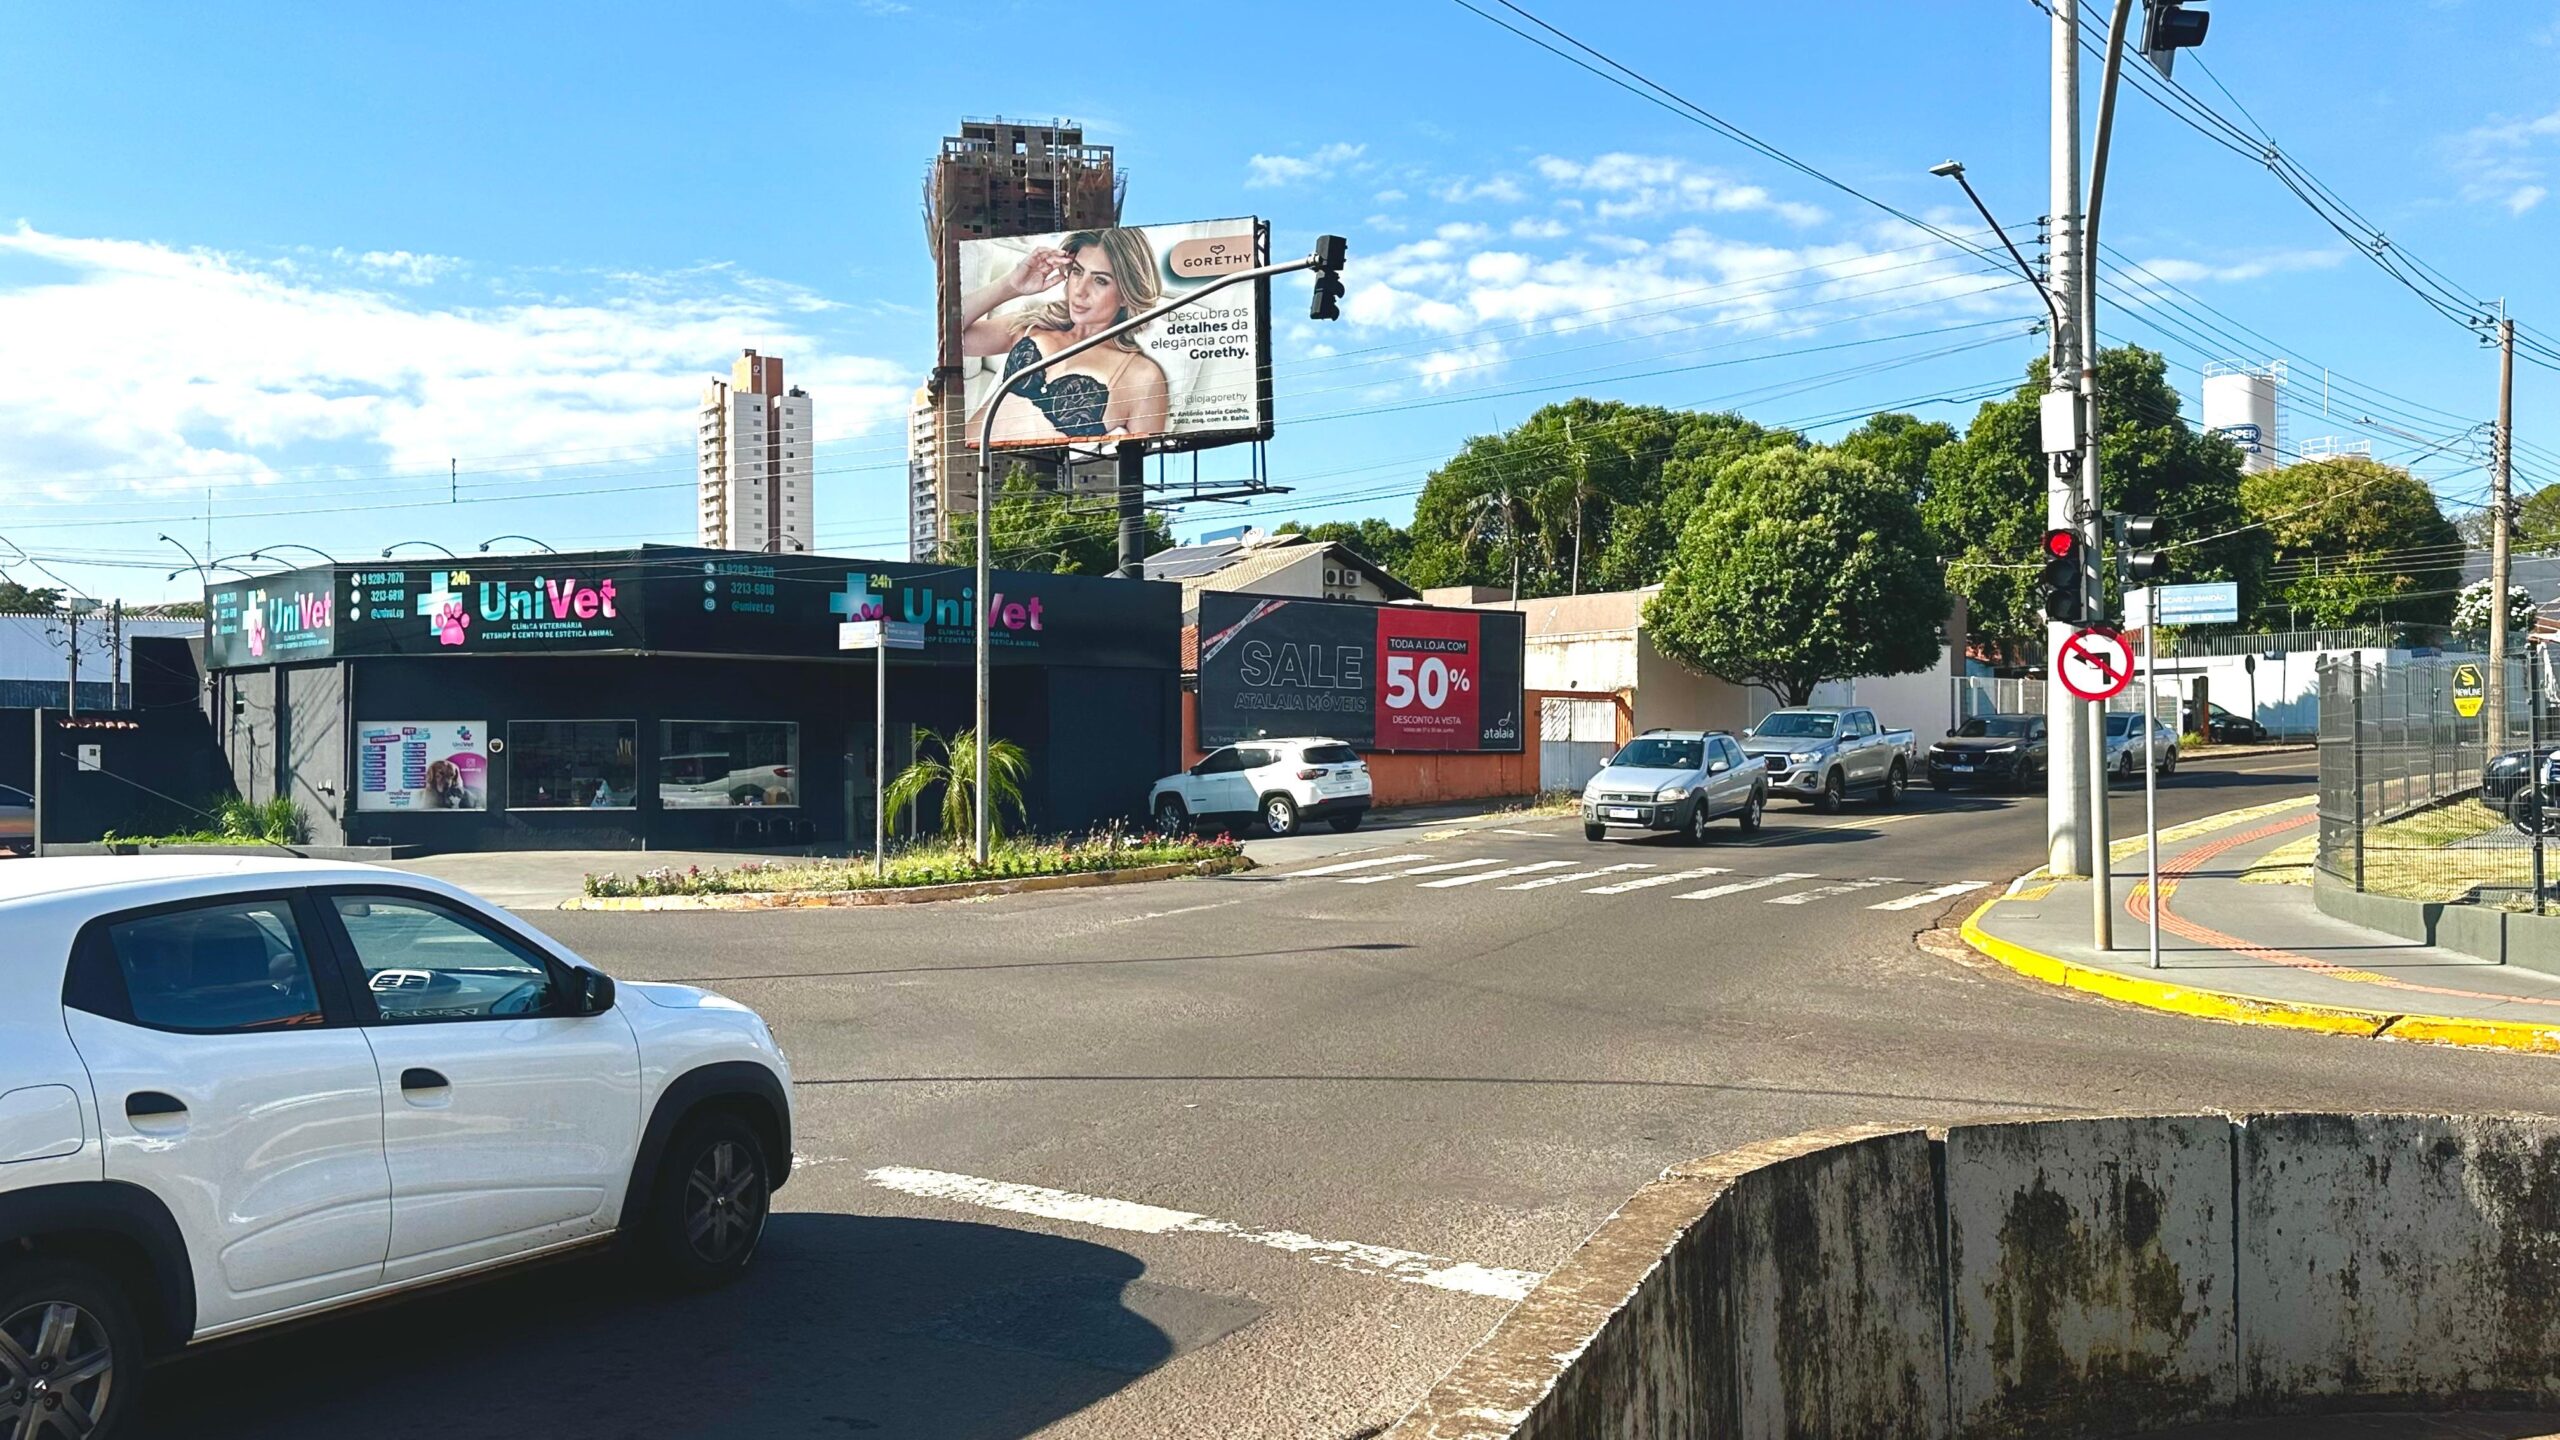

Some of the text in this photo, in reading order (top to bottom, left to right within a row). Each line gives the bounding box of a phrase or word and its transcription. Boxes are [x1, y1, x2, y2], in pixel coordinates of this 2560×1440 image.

[1183, 253, 1251, 268] GORETHY
[1167, 307, 1249, 322] Descubra os
[1167, 319, 1248, 335] detalhes da
[1151, 334, 1249, 351] elegância com
[1189, 346, 1250, 360] Gorethy.
[1185, 392, 1248, 405] @lojagorethy
[450, 570, 471, 586] 24h
[870, 574, 892, 589] 24h
[479, 575, 616, 621] UniVet
[269, 590, 331, 634] UniVet
[482, 632, 511, 640] PETSHOP
[555, 629, 587, 638] ESTÉTICA
[588, 629, 614, 637] ANIMAL
[1390, 639, 1467, 651] TODA A LOJA COM
[1240, 640, 1363, 690] SALE
[1385, 656, 1470, 710] 50%
[1234, 691, 1367, 712] ATALAIA MÓVEIS
[1392, 715, 1433, 725] DESCONTO
[1441, 716, 1462, 725] VISTA
[1483, 727, 1514, 739] atalaia
